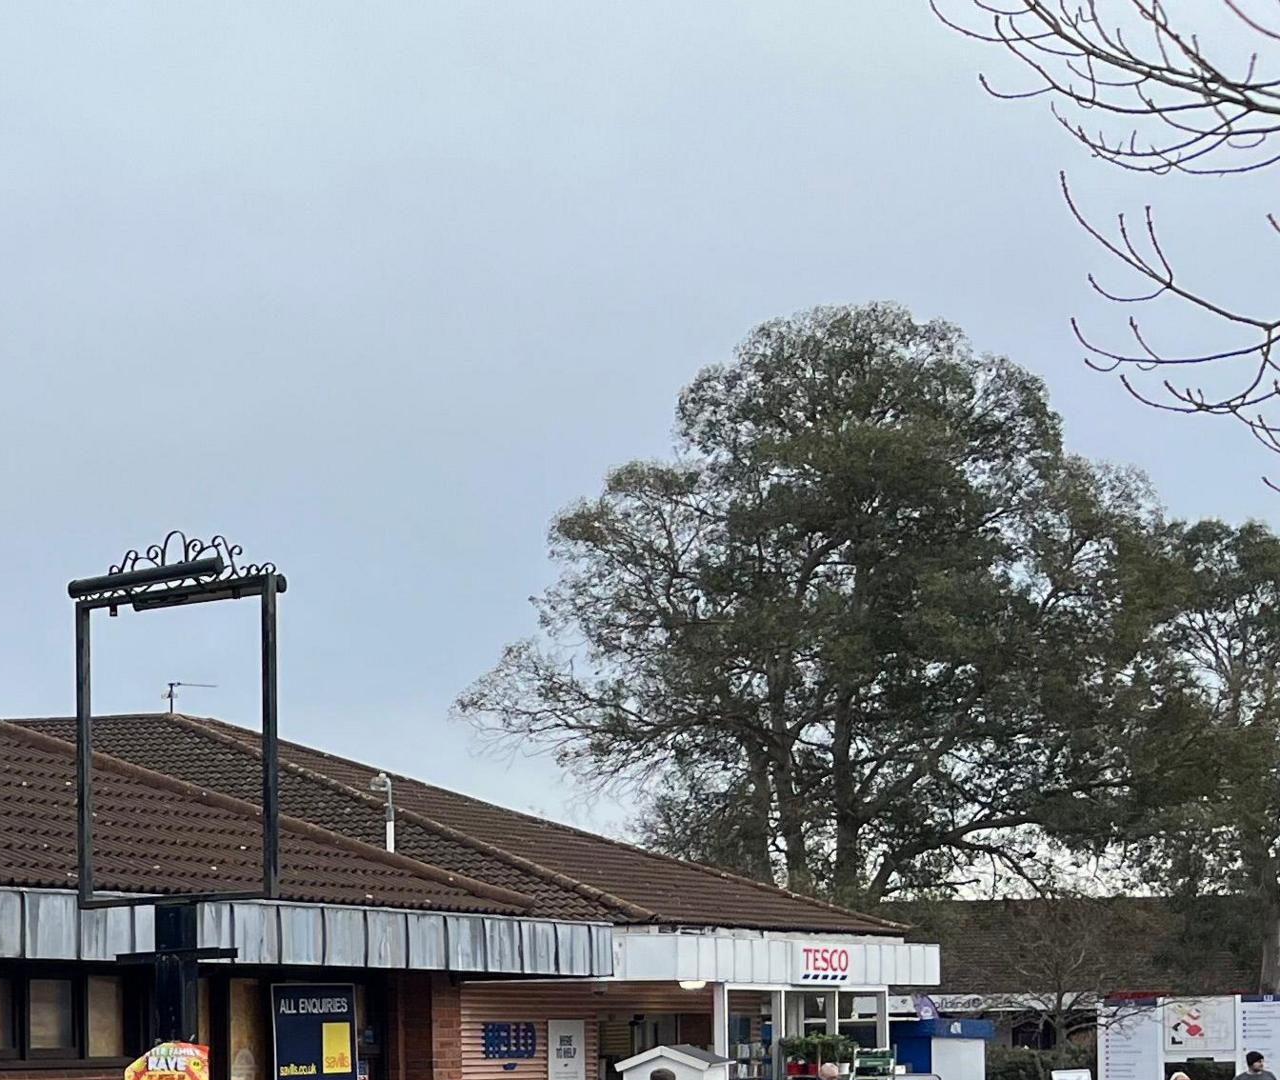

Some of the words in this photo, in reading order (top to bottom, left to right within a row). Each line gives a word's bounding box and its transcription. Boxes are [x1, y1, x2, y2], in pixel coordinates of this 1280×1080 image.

[802, 948, 849, 972] TESCO
[279, 998, 297, 1015] ALL
[298, 997, 348, 1014] ENQUIRIES
[147, 1056, 187, 1071] RAVE
[324, 1051, 350, 1069] savills
[279, 1062, 317, 1077] savills.co.uk
